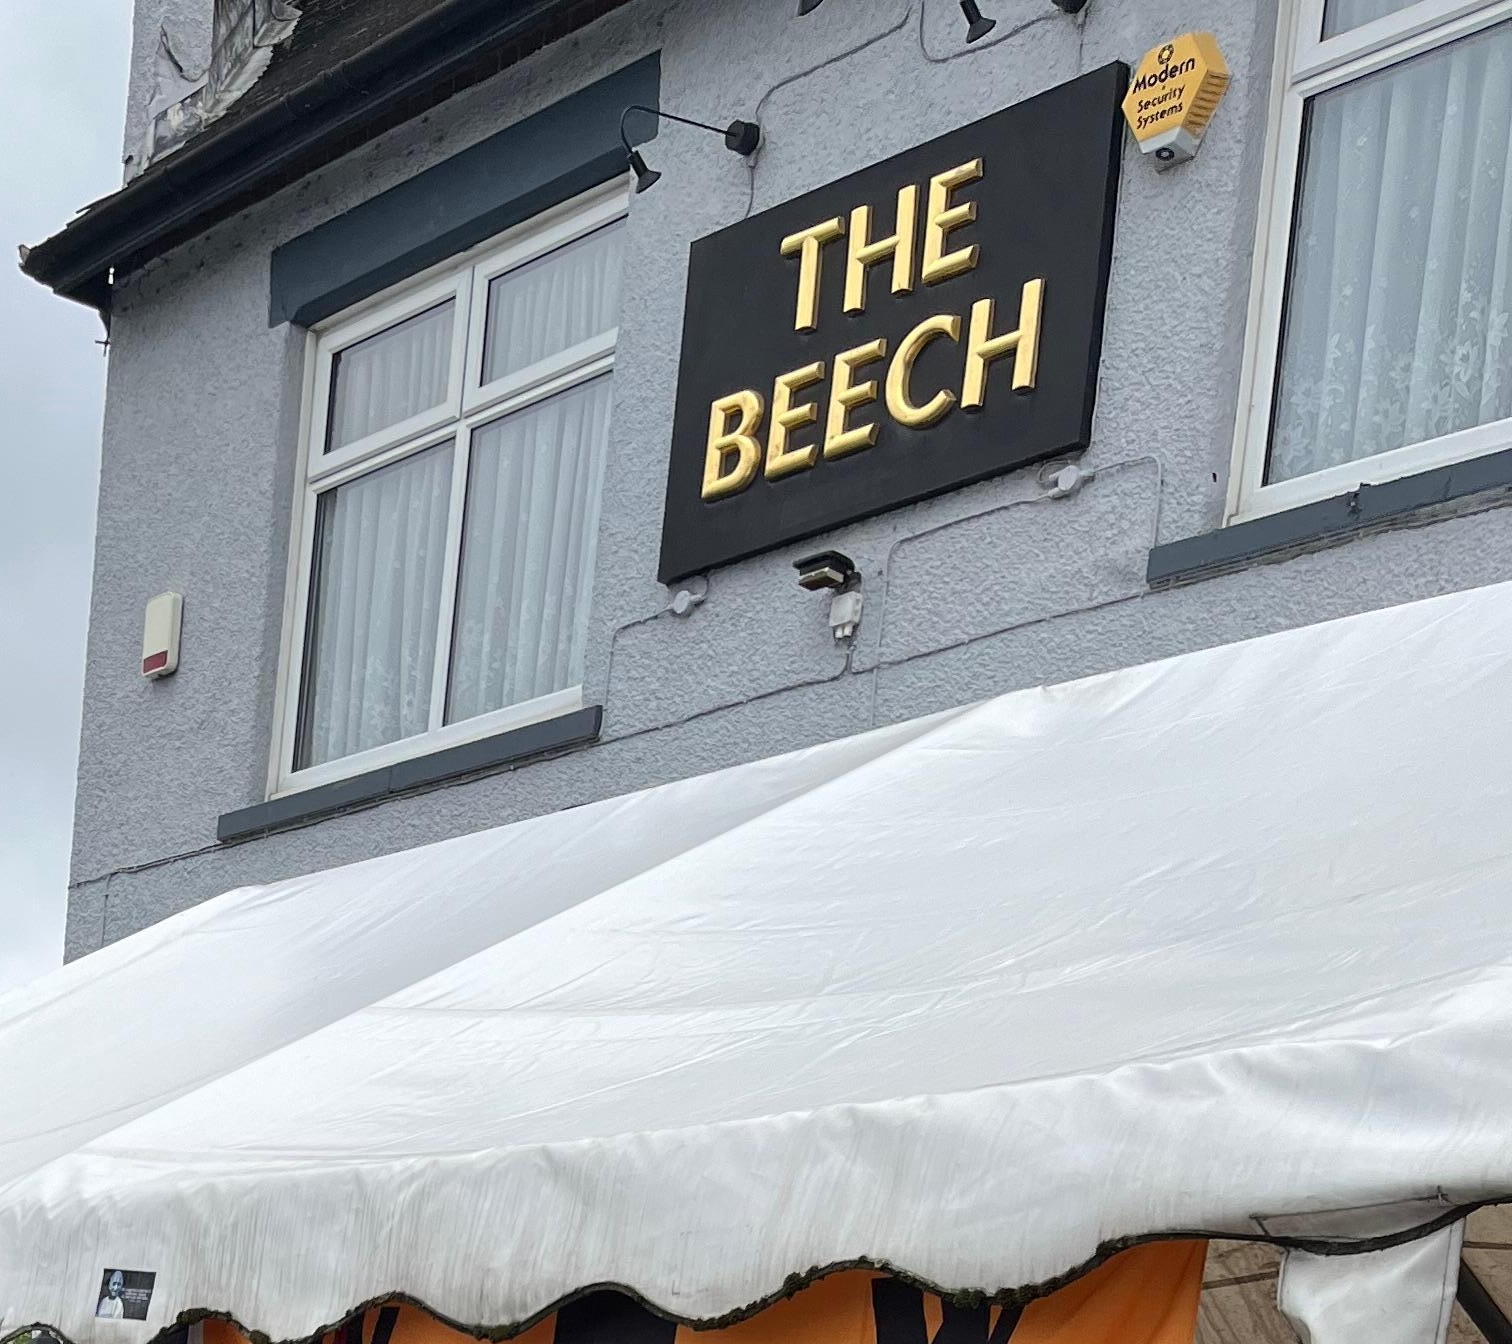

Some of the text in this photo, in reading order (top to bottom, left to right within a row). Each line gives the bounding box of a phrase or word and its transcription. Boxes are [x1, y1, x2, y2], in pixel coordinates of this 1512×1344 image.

[1132, 57, 1196, 95] Modern
[1136, 102, 1183, 130] Systems
[1137, 84, 1186, 113] Security
[780, 158, 983, 332] THE
[700, 277, 1044, 500] BEECH
